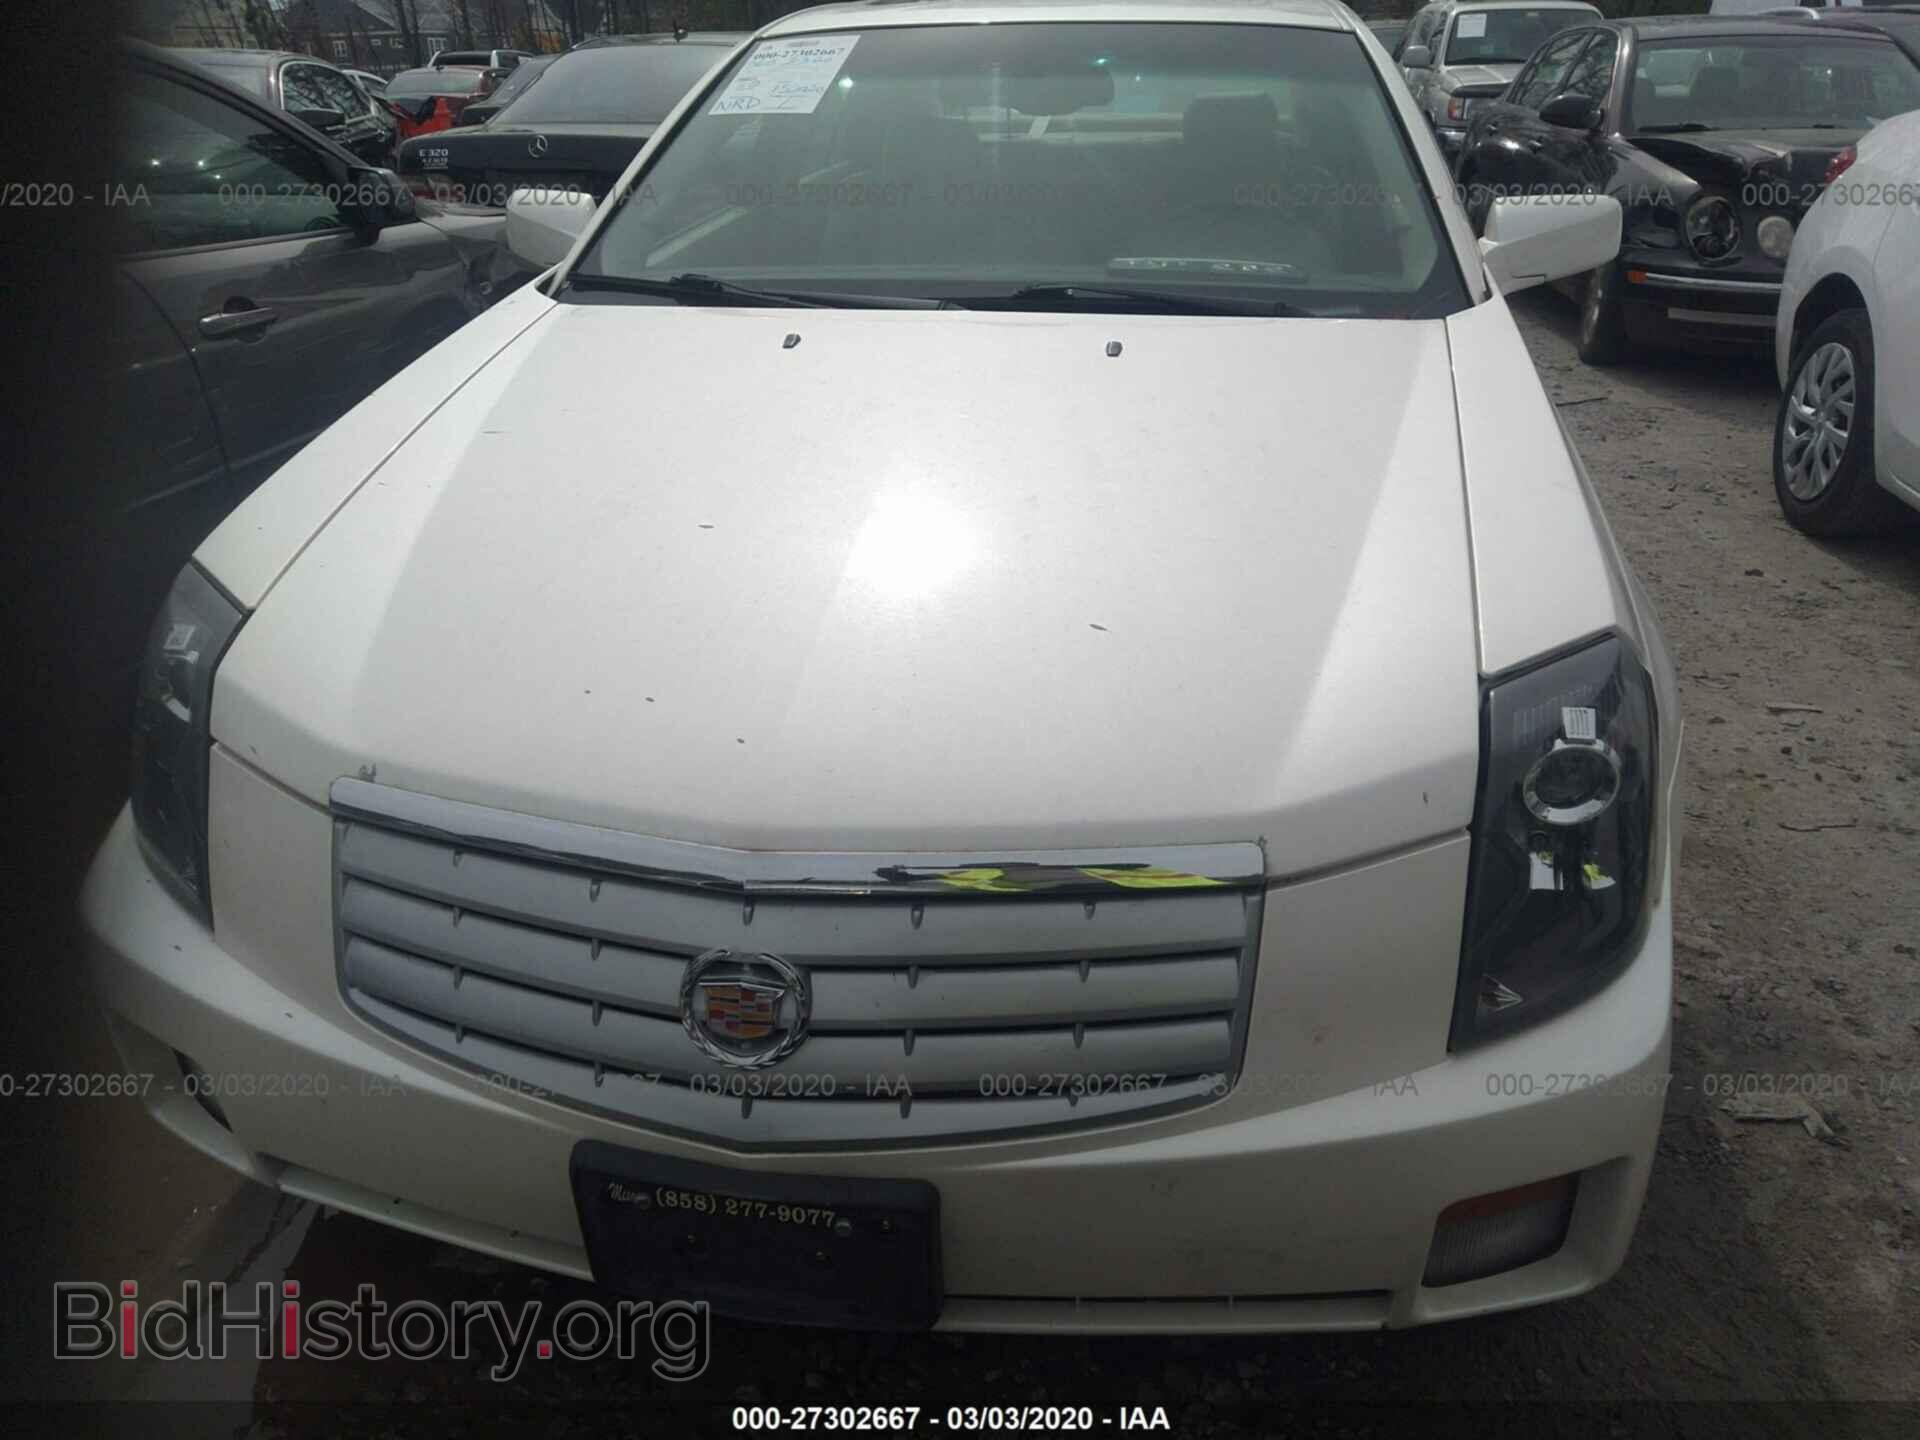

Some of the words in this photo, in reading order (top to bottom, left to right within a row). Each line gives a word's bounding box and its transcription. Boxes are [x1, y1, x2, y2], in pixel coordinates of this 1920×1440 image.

[419, 148, 427, 157] E
[429, 148, 449, 157] 320
[655, 1187, 717, 1213] (858)
[724, 1198, 836, 1228] 277-9077
